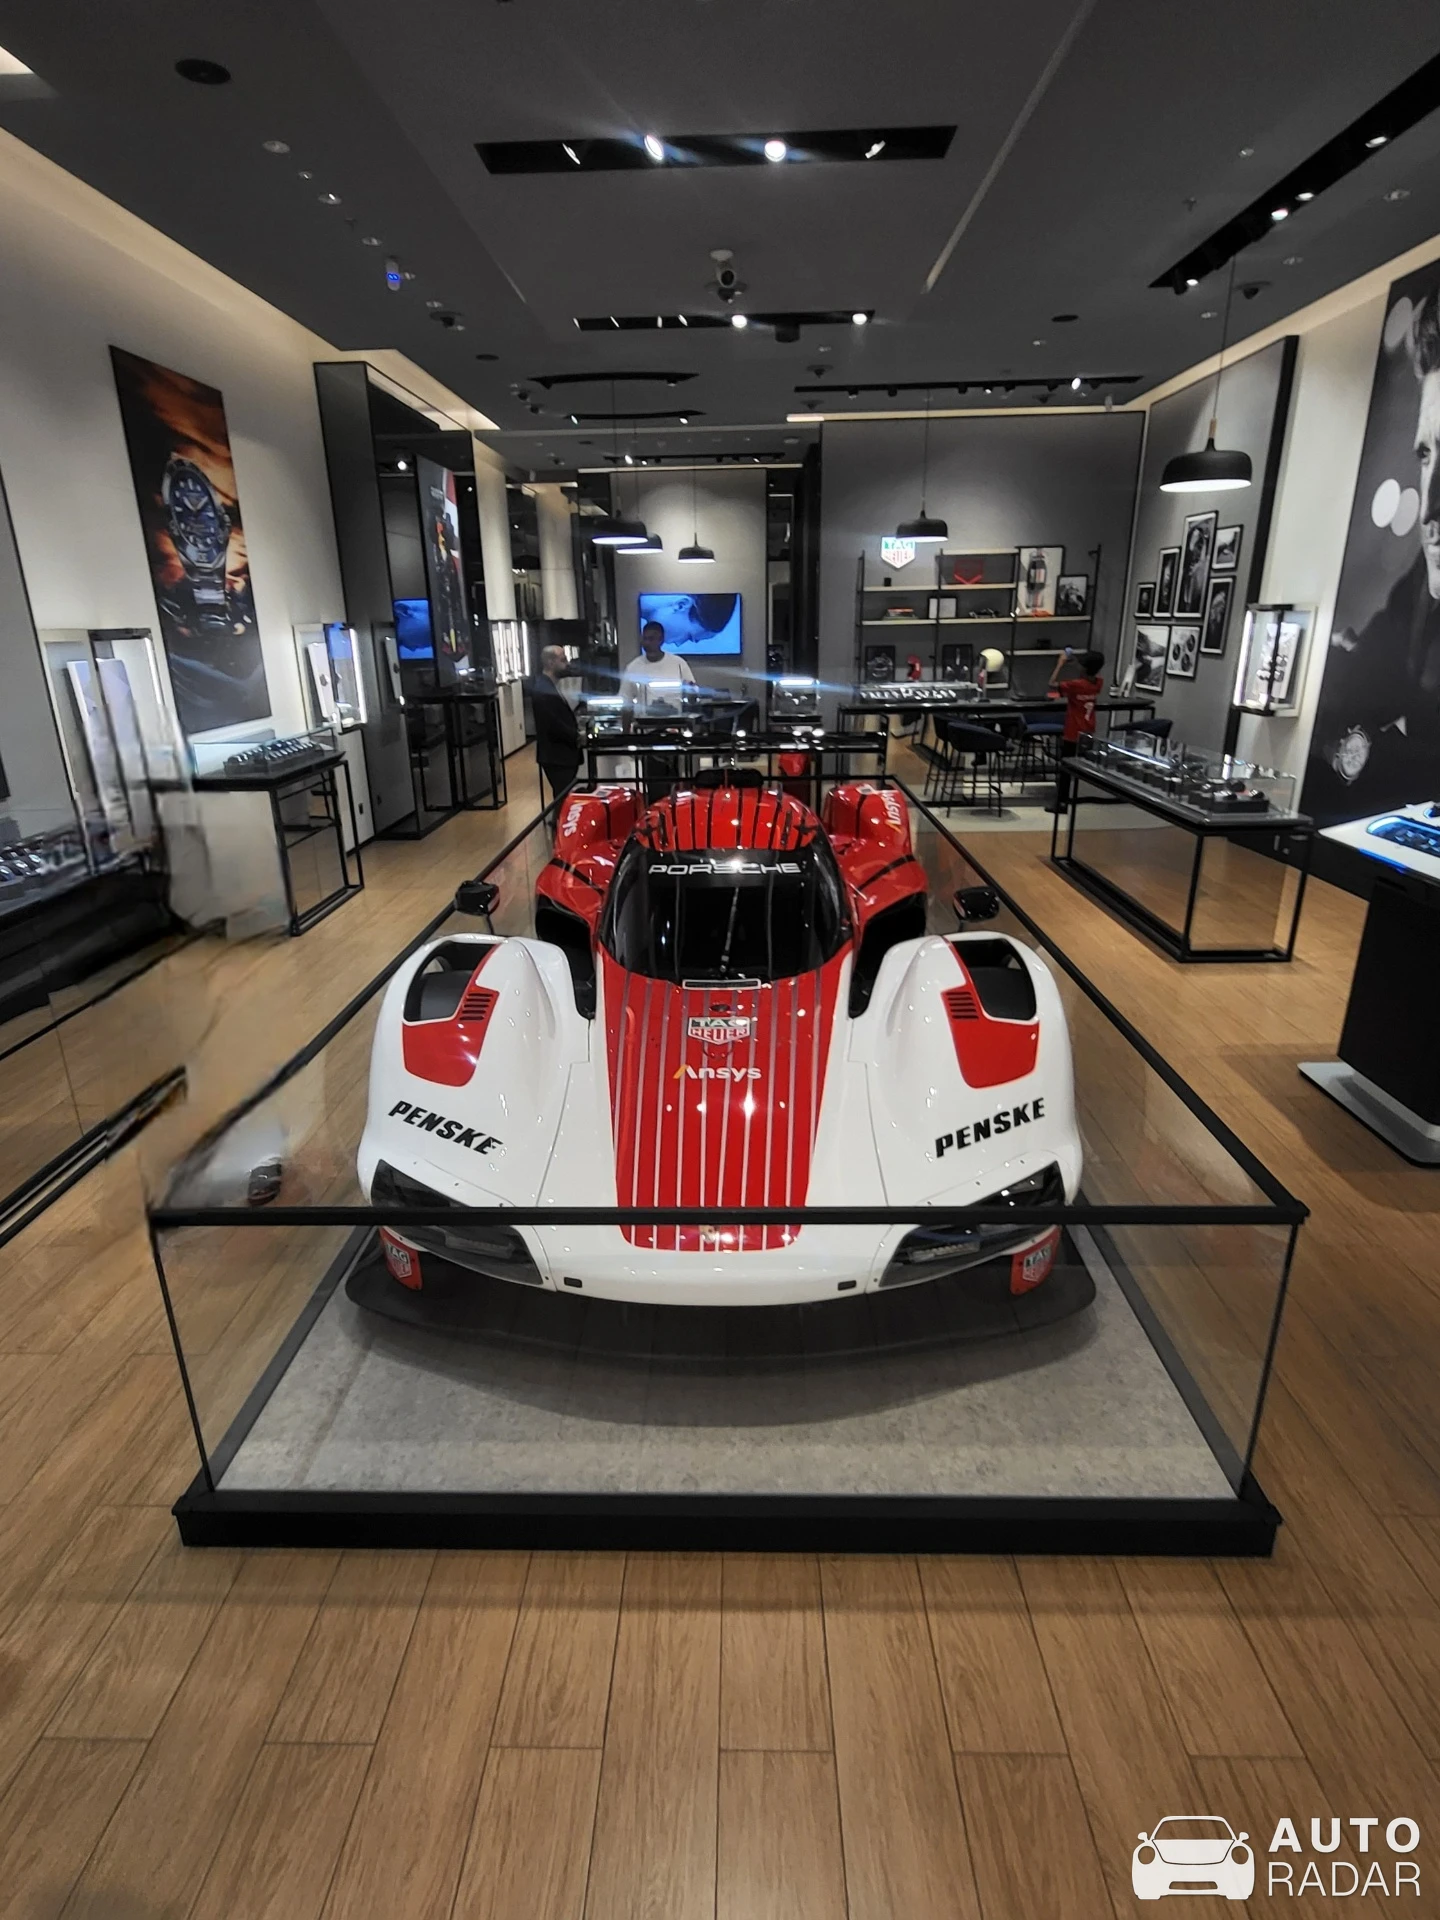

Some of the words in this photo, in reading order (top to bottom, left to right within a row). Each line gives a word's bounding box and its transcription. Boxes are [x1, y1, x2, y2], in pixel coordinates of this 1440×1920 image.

[649, 862, 801, 875] PORSCHE
[696, 1017, 747, 1027] TAG
[690, 1028, 747, 1042] HEUER
[673, 1064, 762, 1082] Ansys
[388, 1100, 504, 1155] PENSKE
[935, 1097, 1045, 1158] PENSKE
